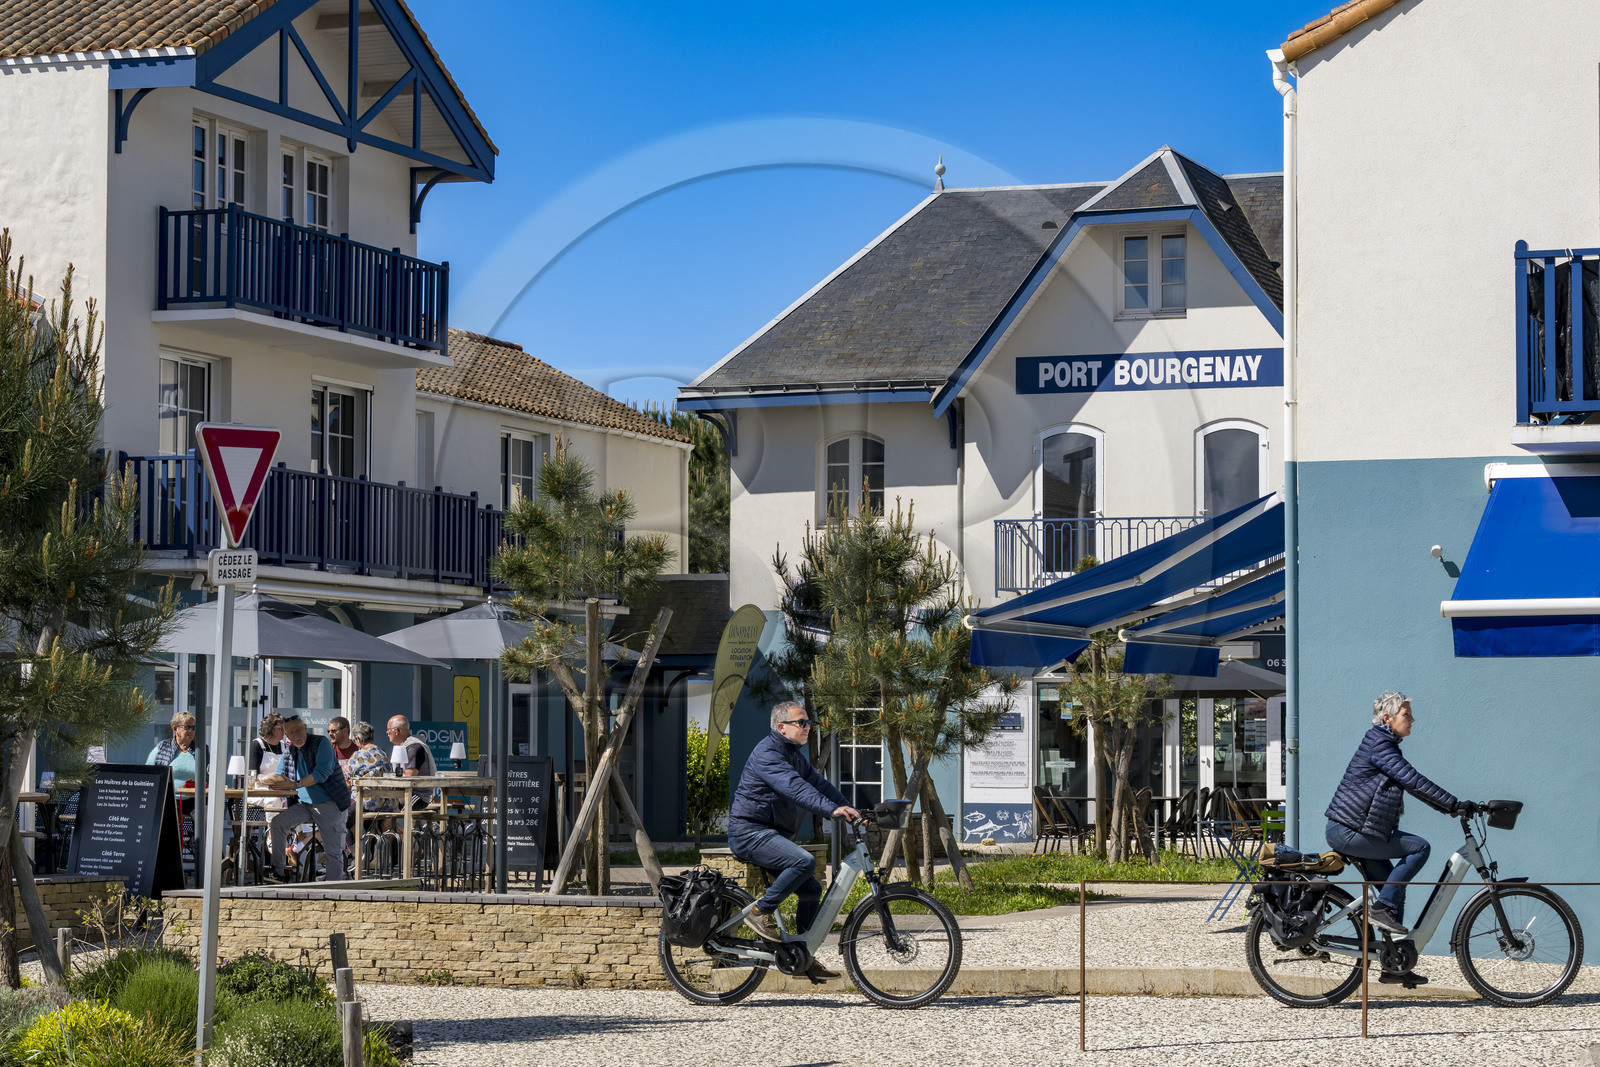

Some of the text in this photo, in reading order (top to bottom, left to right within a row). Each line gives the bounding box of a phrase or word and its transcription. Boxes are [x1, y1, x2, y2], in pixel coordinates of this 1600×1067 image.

[1038, 355, 1263, 388] PORT BOURGENAY
[218, 553, 253, 566] CÉDEZ LE
[218, 568, 252, 579] PASSAGE
[1266, 658, 1280, 667] 06
[531, 796, 540, 804] 9€
[527, 807, 539, 815] 17€
